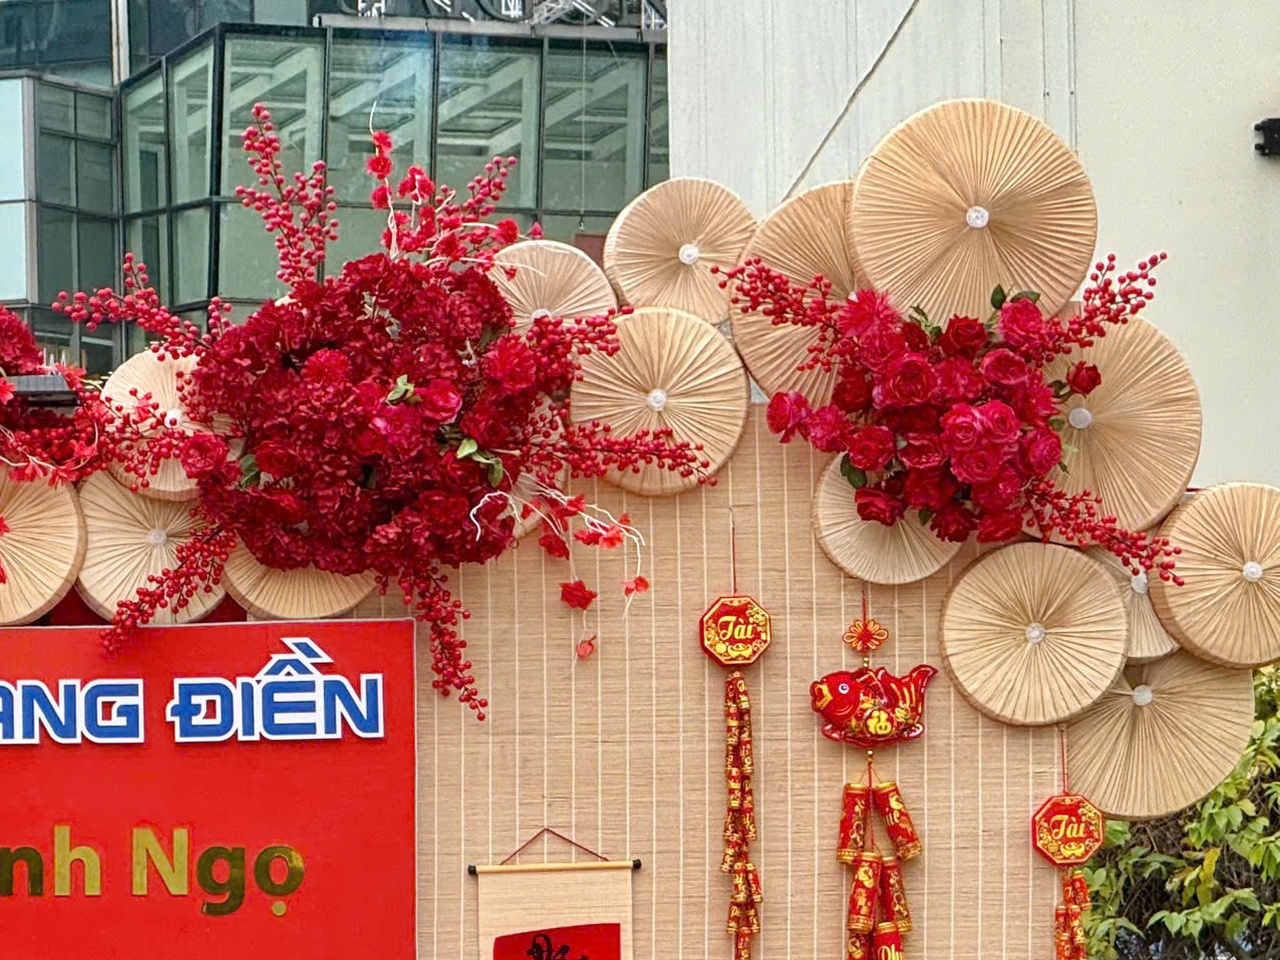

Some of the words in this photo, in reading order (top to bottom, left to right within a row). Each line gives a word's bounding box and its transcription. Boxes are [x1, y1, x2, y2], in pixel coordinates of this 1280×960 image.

[718, 615, 754, 640] Tài
[166, 637, 385, 743] ĐIỀN
[1050, 814, 1086, 840] Tài
[132, 828, 305, 917] Ngọ
